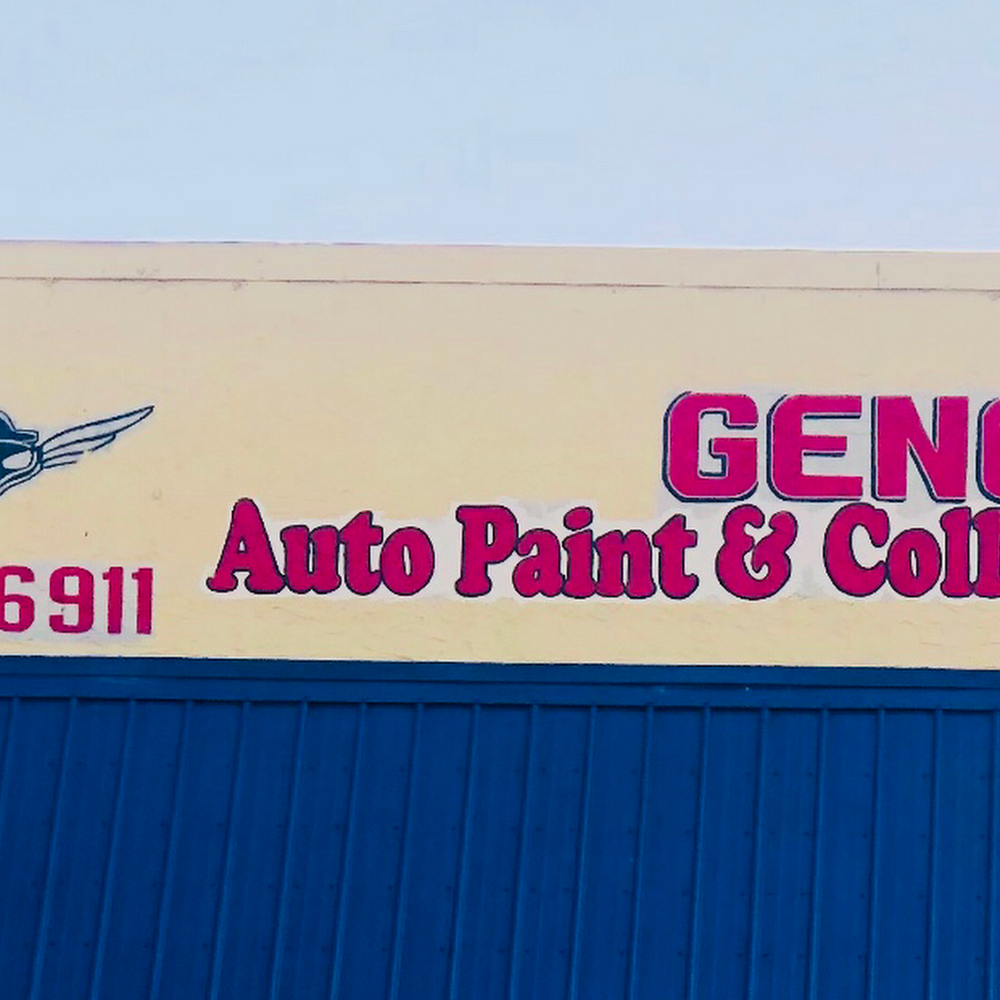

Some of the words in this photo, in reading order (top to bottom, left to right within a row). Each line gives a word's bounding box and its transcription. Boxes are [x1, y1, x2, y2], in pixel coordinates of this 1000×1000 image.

[206, 497, 435, 596] Auto
[454, 504, 700, 600] Paint
[715, 503, 798, 600] &
[0, 565, 153, 634] 6911
